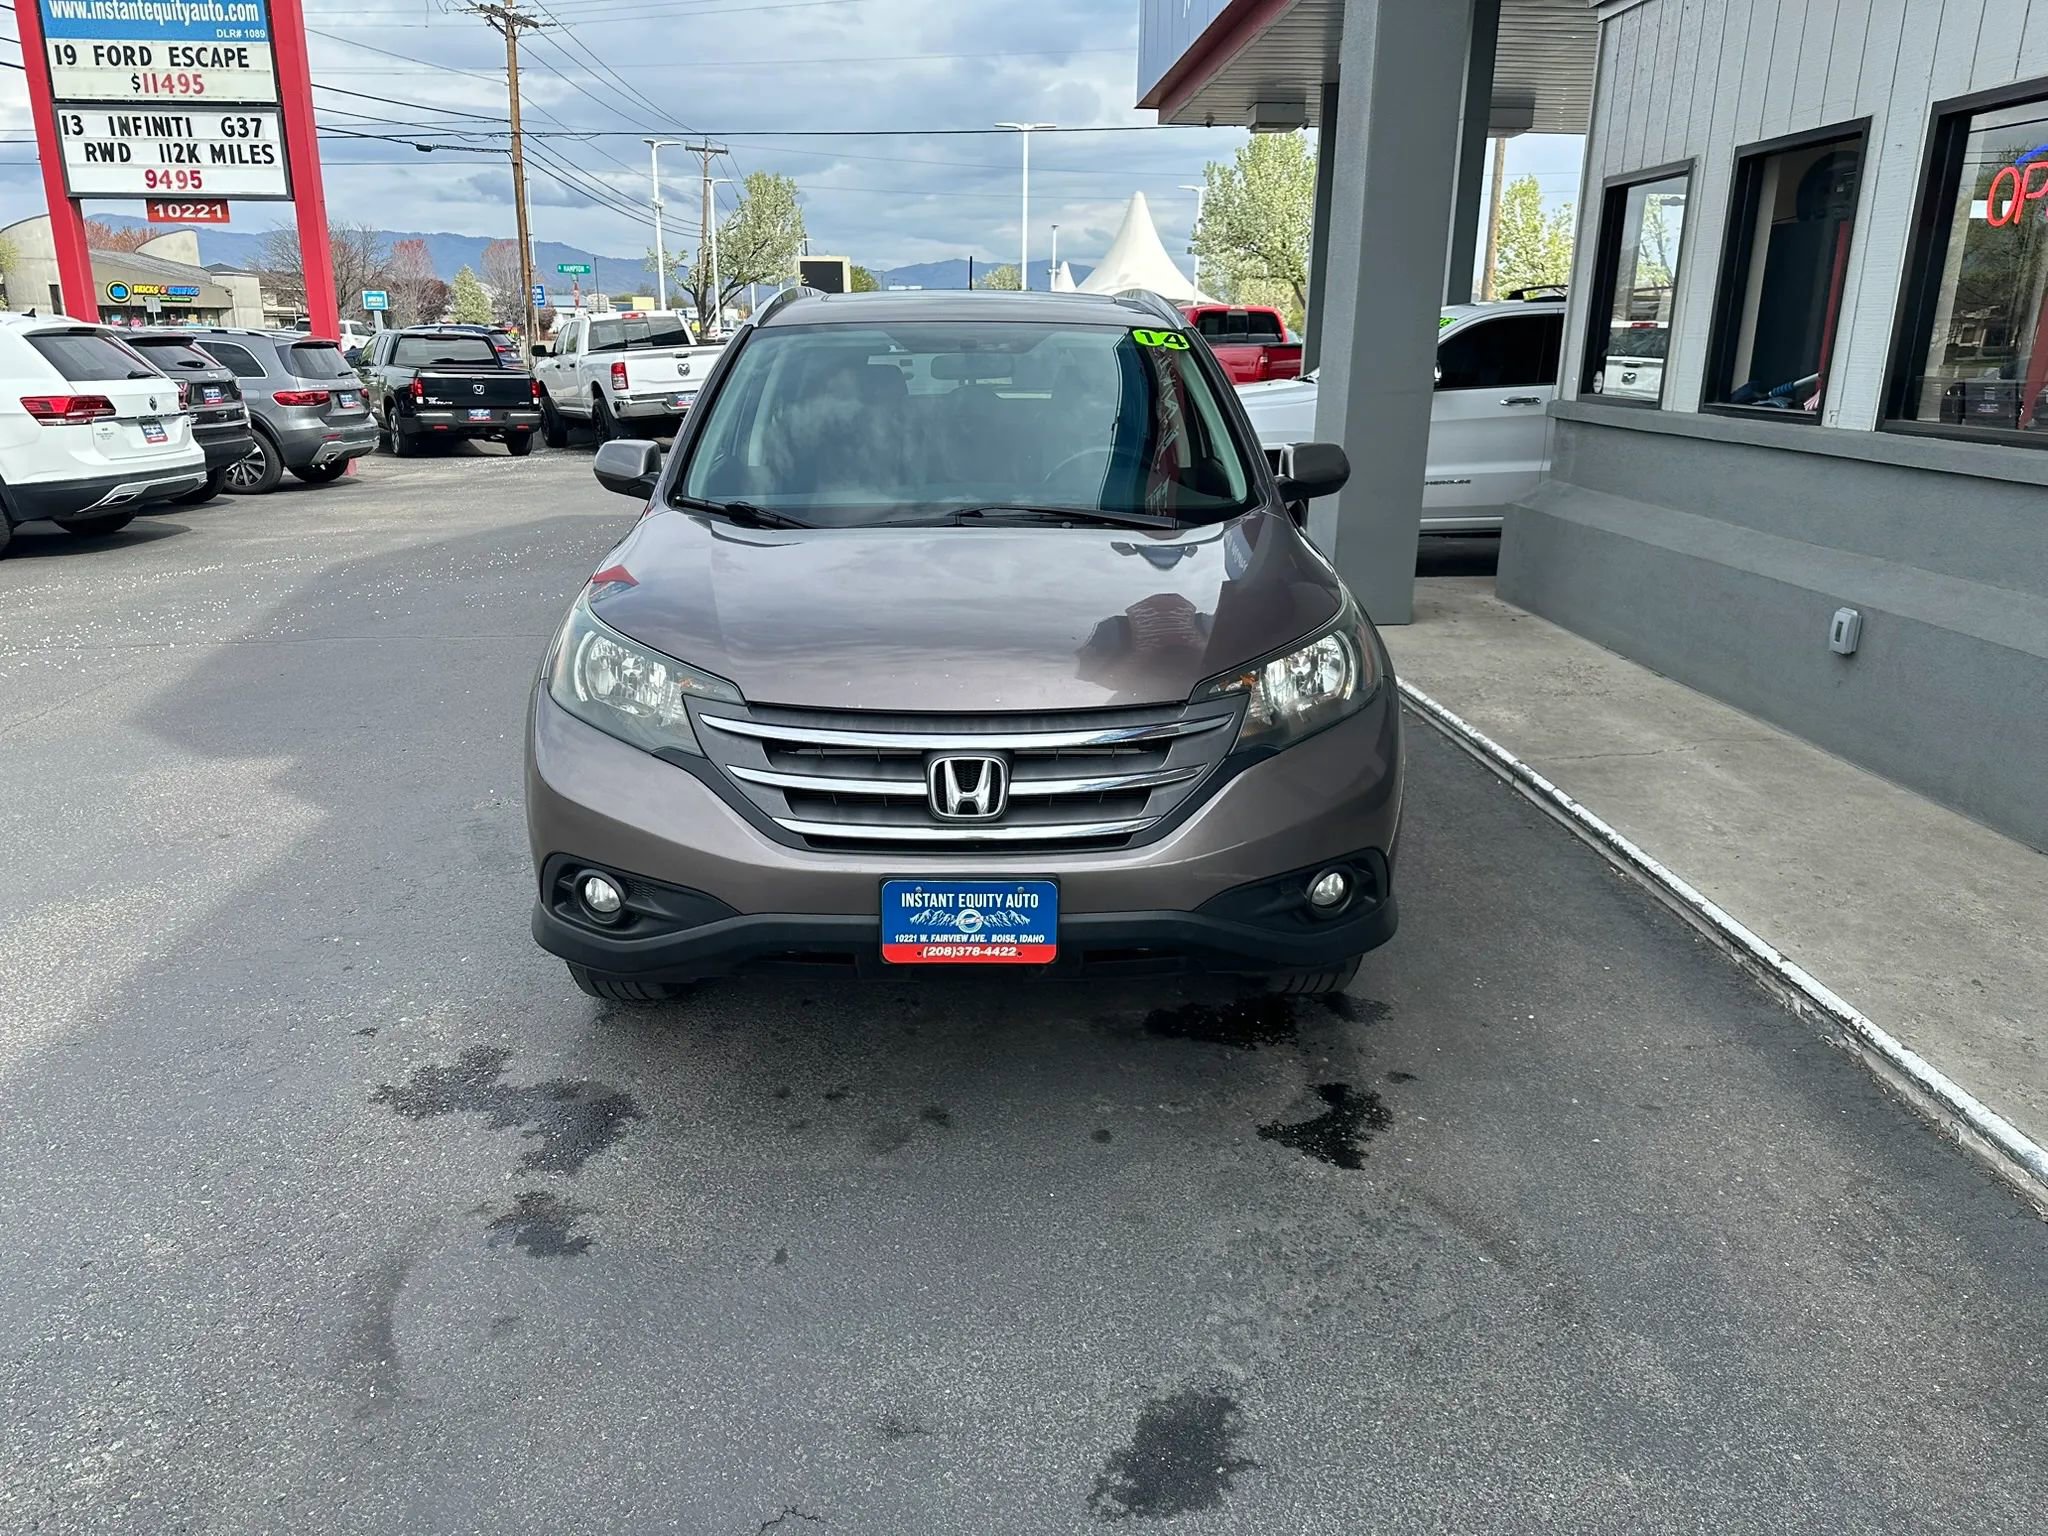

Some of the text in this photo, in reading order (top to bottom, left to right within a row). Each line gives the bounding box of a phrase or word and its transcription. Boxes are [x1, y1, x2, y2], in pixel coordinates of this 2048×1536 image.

[51, 0, 259, 26] www.instantequityauto.com
[216, 29, 266, 39] DLR# 1089
[54, 44, 250, 68] 19 FORD ESCAPE
[131, 72, 205, 95] $11495
[61, 115, 262, 138] 13 INFINITI G37
[84, 142, 275, 165] RWD 112K MILES
[145, 169, 202, 190] 9495
[153, 203, 223, 219] 10221
[133, 284, 159, 295] BRICKS
[1140, 331, 1187, 348] 14
[901, 893, 1039, 908] INSTANT EQUITY AUTO
[894, 934, 1045, 944] 10221 W. FAIRVIEW AVE. BOISE, IDAHO
[922, 946, 1017, 959] (208)378-4422
